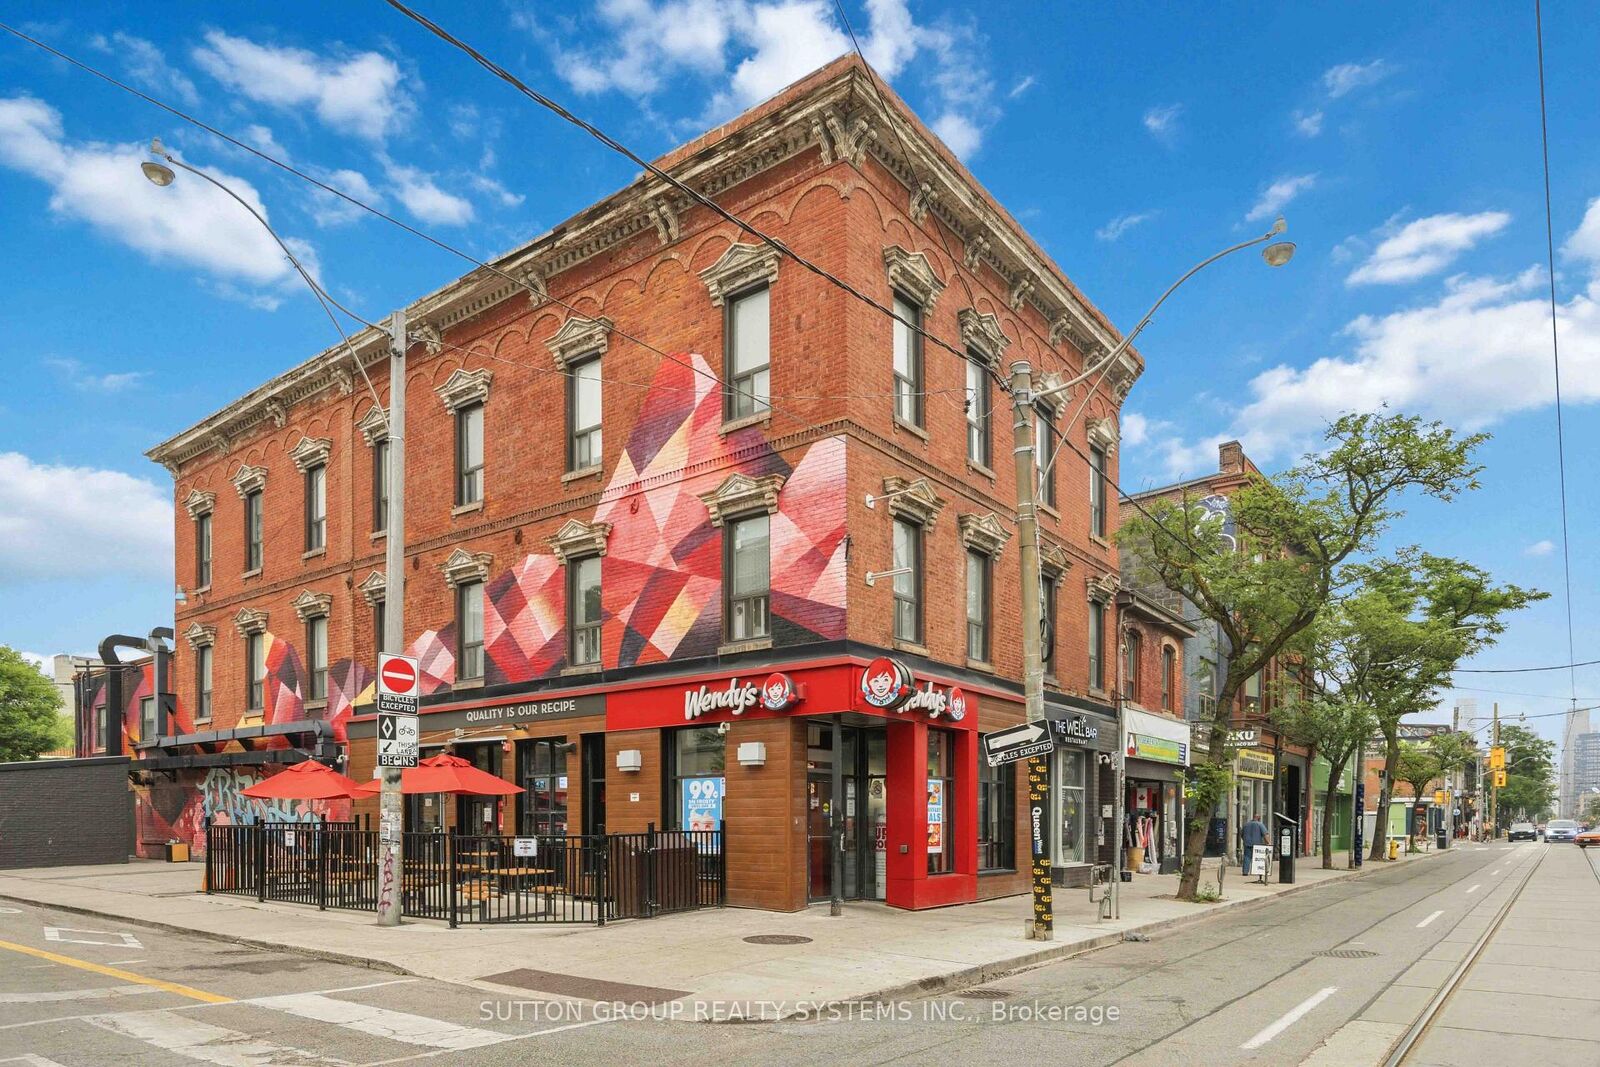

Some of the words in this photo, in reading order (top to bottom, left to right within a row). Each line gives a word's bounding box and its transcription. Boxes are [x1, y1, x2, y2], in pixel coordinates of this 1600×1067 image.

[380, 701, 416, 712] EXCEPTED
[382, 693, 415, 704] BICYCLES
[684, 678, 758, 720] Wendy's
[466, 709, 503, 722] QUALITY
[506, 707, 515, 718] IS
[517, 704, 538, 716] OUR
[541, 700, 576, 714] RECIPE
[1055, 720, 1066, 734] THE
[1066, 719, 1085, 737] WELL
[1085, 727, 1098, 739] BAR
[1019, 742, 1053, 756] EXCEPTED
[1032, 806, 1042, 840] Queen
